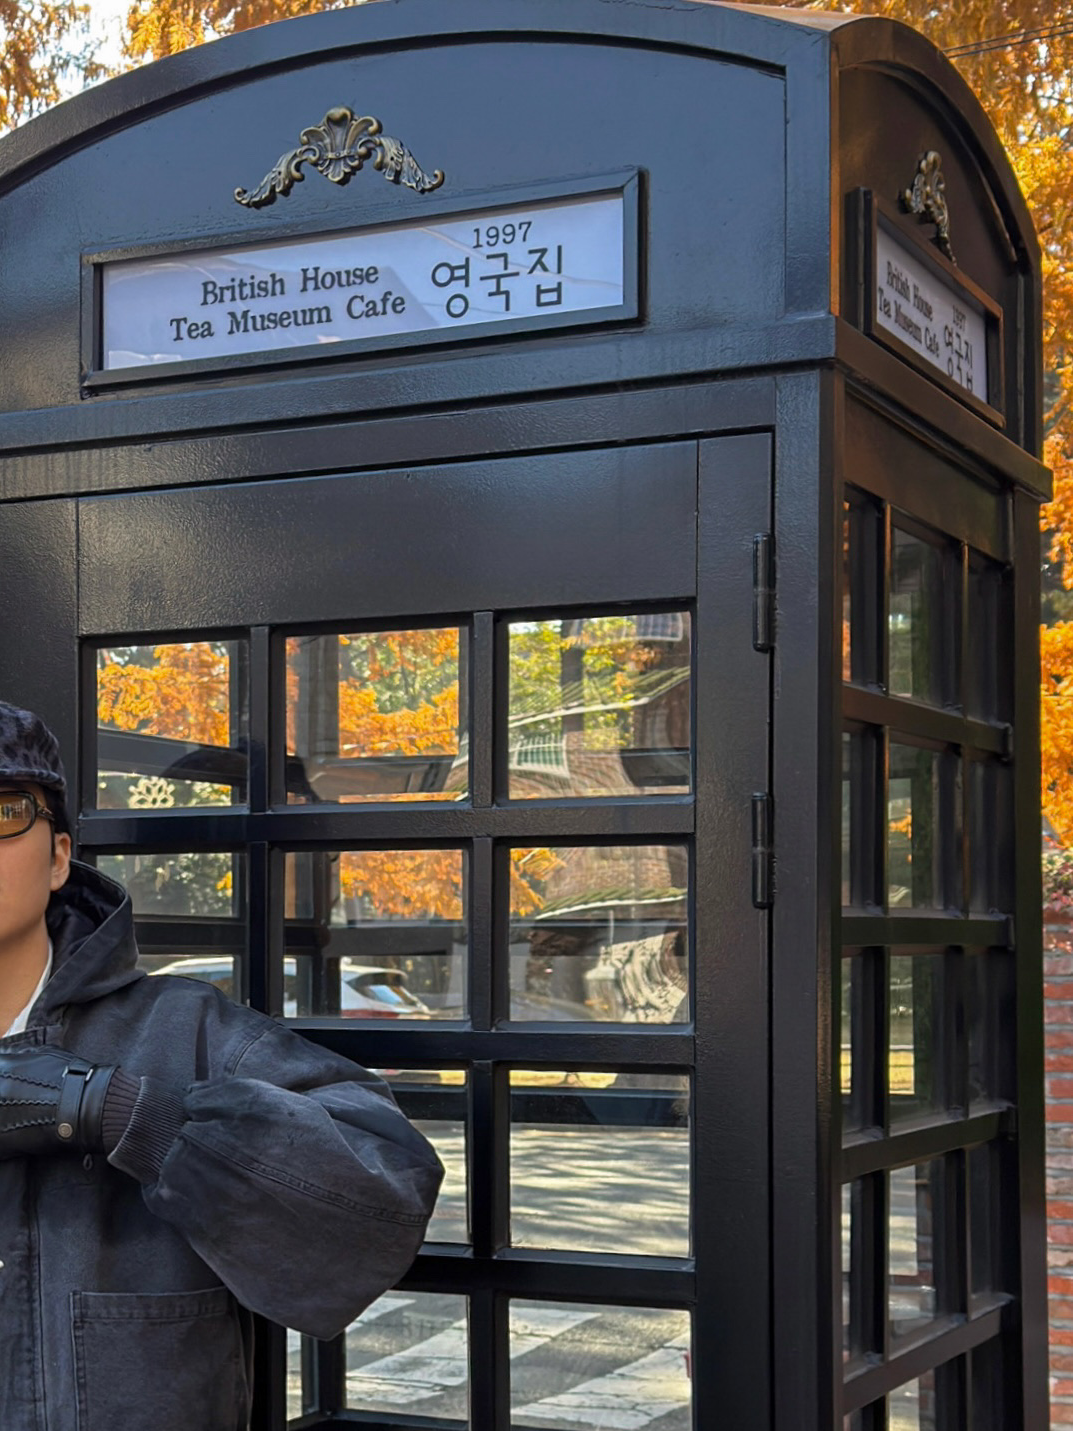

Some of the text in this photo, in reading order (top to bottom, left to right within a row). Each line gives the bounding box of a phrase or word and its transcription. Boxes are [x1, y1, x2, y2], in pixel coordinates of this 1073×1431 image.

[472, 221, 532, 249] 1997
[200, 265, 379, 306] British House
[431, 245, 562, 318] 영국집
[169, 291, 406, 342] Tea Museum Cafe
[944, 325, 973, 392] 영국집
